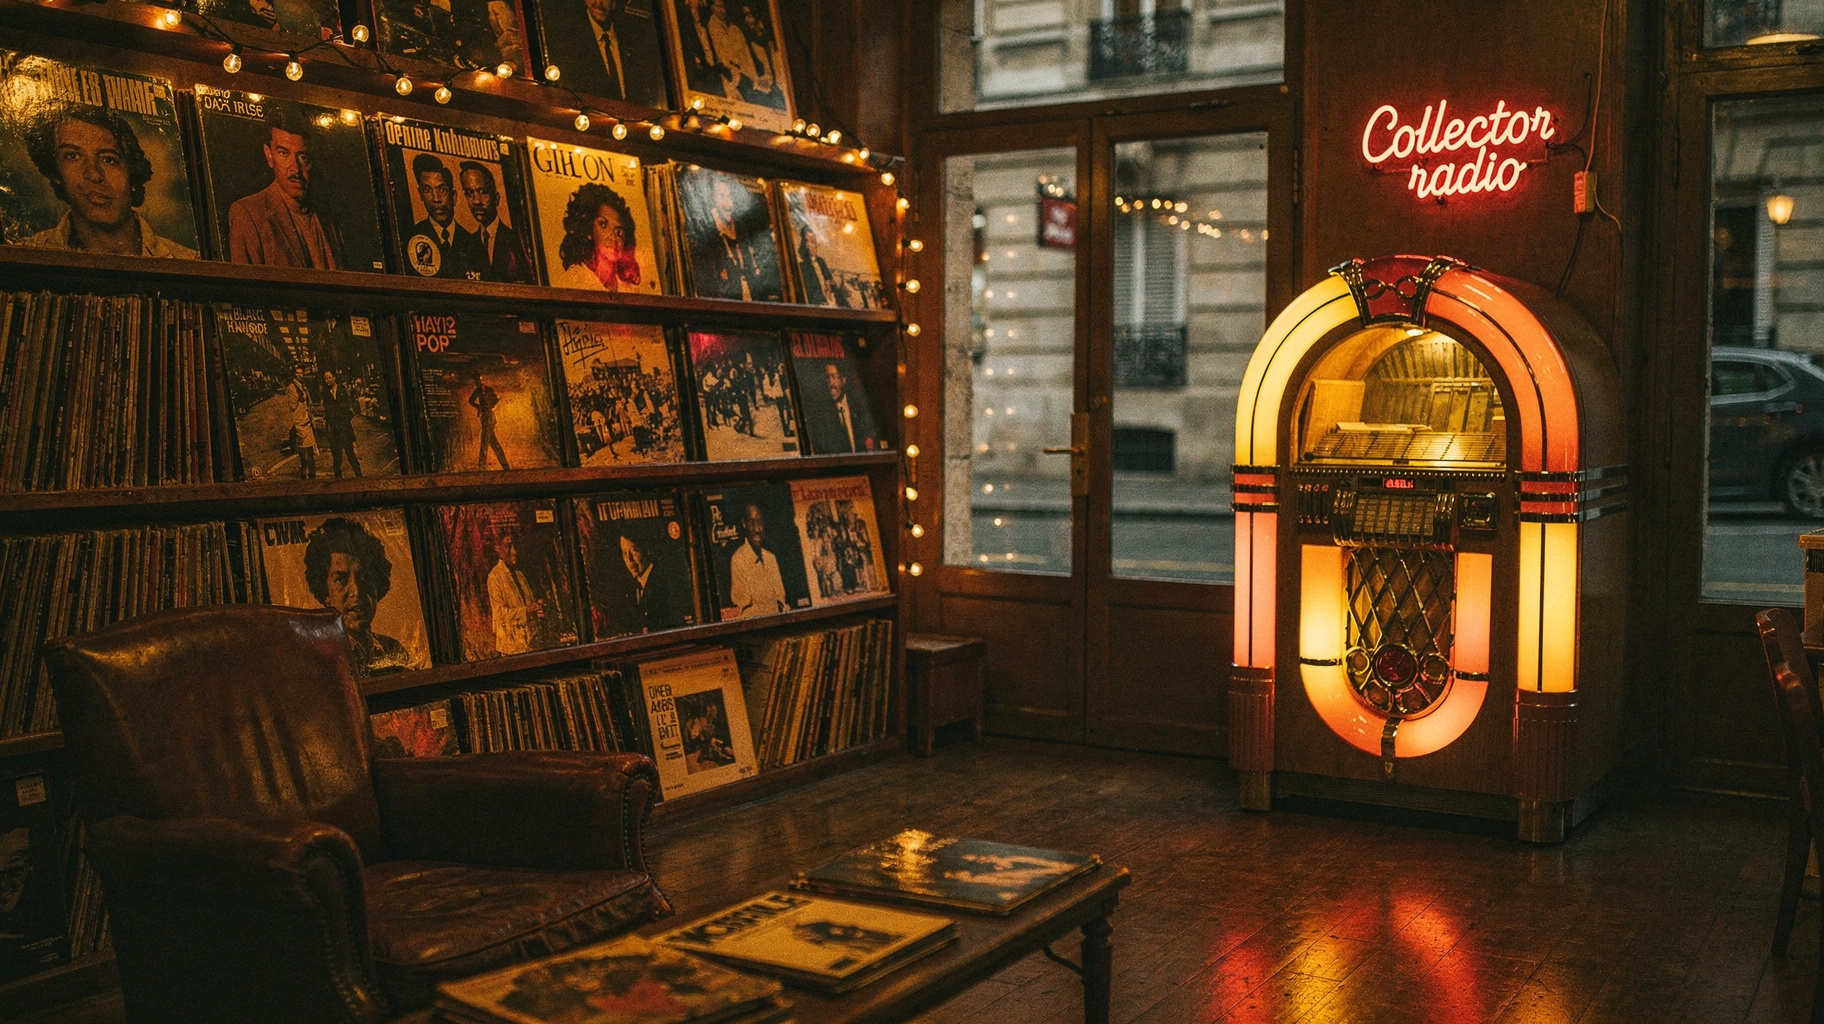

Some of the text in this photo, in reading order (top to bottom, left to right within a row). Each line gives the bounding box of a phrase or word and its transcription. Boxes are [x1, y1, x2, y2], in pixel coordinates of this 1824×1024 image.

[1362, 99, 1555, 163] Collector
[1408, 146, 1528, 198] radio
[416, 333, 449, 353] POP
